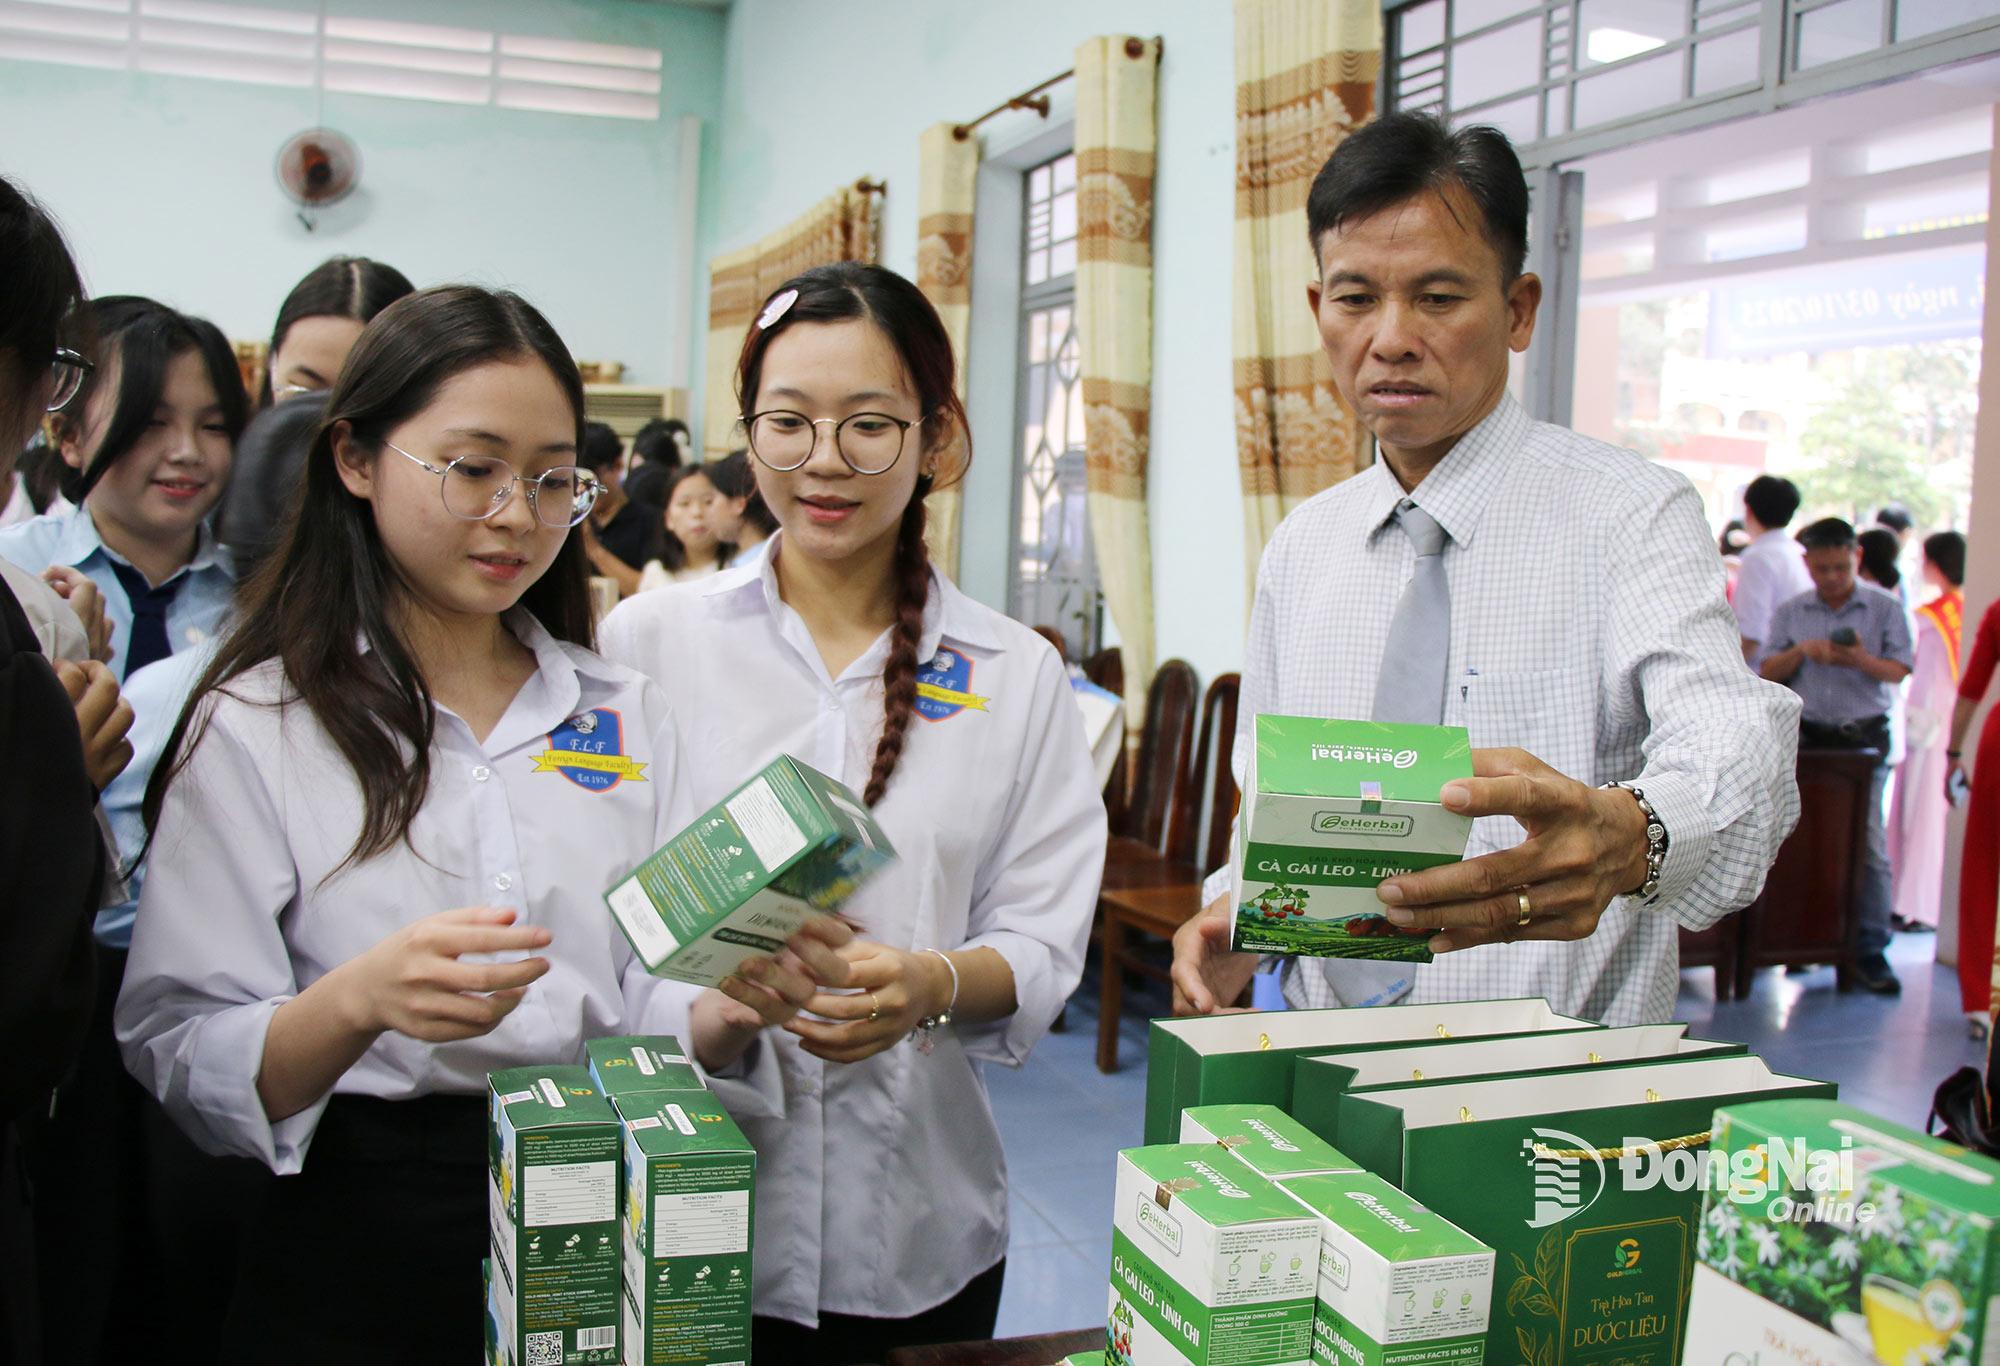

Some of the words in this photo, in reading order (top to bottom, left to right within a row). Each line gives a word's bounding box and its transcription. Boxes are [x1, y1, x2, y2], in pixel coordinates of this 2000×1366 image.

[1312, 748, 1394, 763] eHerbal
[1340, 818, 1405, 830] eHerbal
[1286, 863, 1317, 875] GAI
[1322, 864, 1355, 876] LEO
[1321, 1252, 1346, 1277] erbal
[1124, 1266, 1138, 1291] GAI
[1139, 1281, 1155, 1306] LEO
[1160, 1300, 1182, 1331] LINH
[1183, 1320, 1201, 1347] CHI
[1315, 1316, 1365, 1366] ROCUMBENS
[1386, 1353, 1426, 1364] NUTRITION
[1427, 1350, 1450, 1359] FACTS
